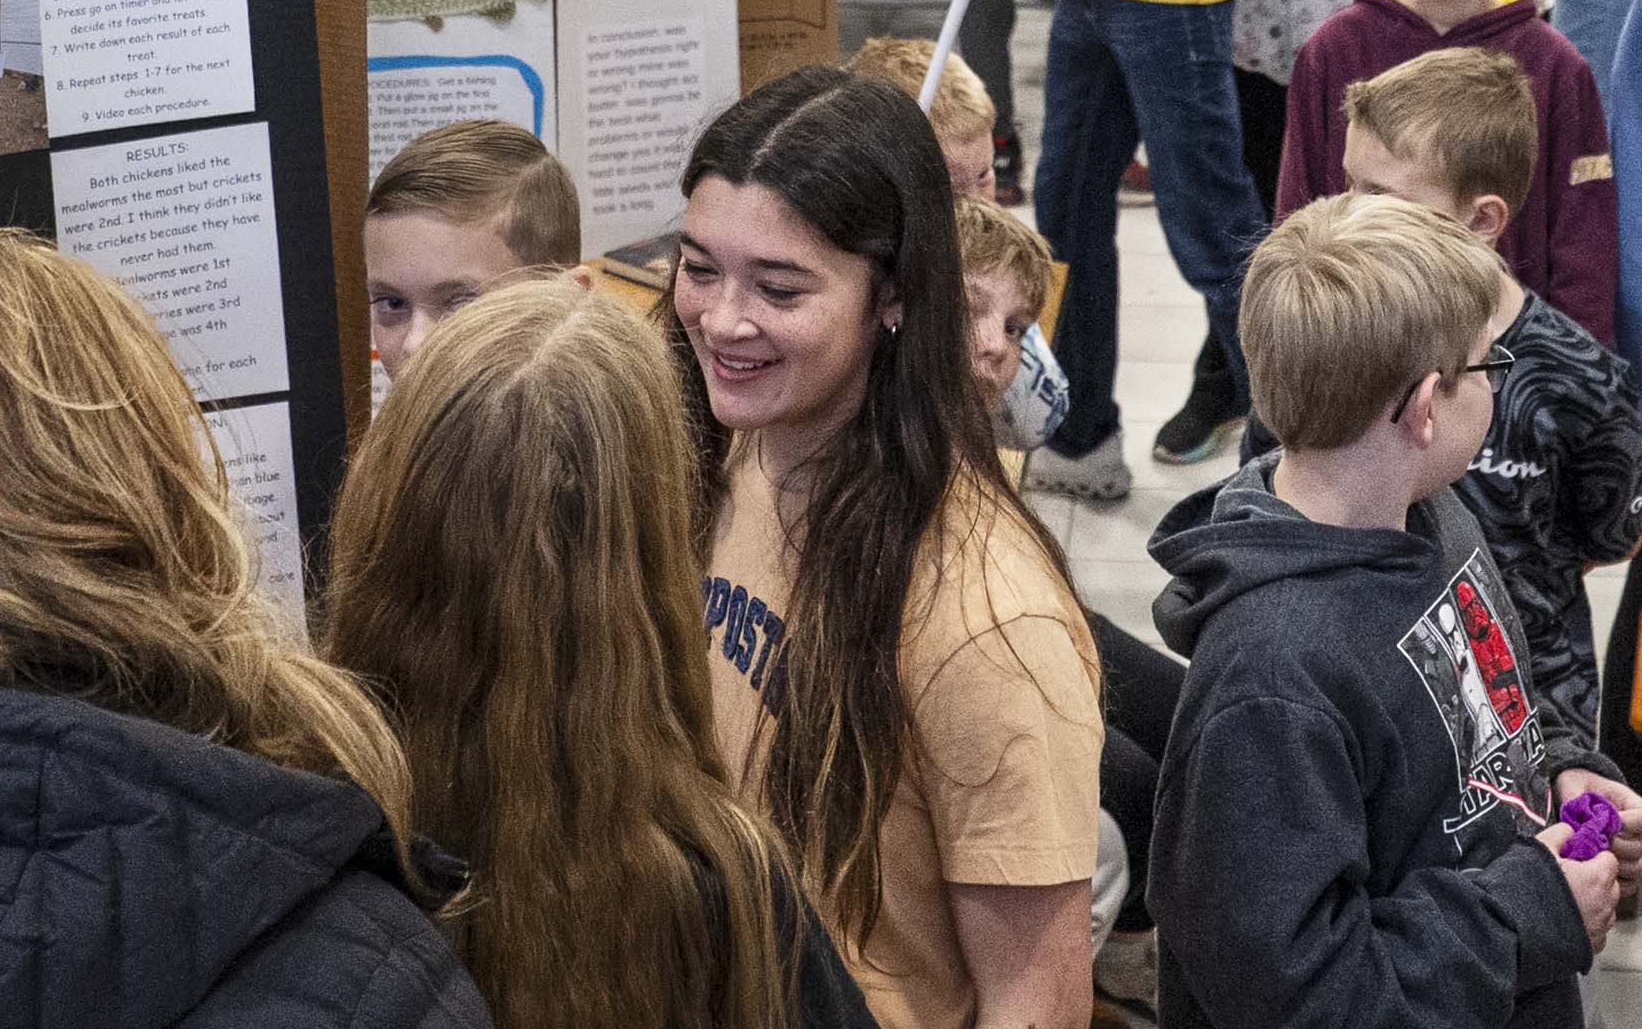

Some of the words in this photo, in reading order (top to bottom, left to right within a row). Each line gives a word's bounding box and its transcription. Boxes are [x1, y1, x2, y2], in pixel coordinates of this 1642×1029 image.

[89, 175, 118, 189] Both
[122, 166, 173, 183] chickens
[177, 158, 205, 173] liked
[209, 156, 230, 167] the
[61, 195, 127, 214] mealworms
[131, 190, 152, 201] the
[155, 184, 183, 197] most
[187, 179, 208, 192] but
[212, 172, 261, 188] crickets
[72, 241, 93, 253] the
[96, 232, 146, 250] crickets
[149, 224, 197, 239] because
[201, 218, 228, 230] they
[232, 214, 259, 224] have
[120, 252, 153, 265] never
[157, 245, 179, 258] had
